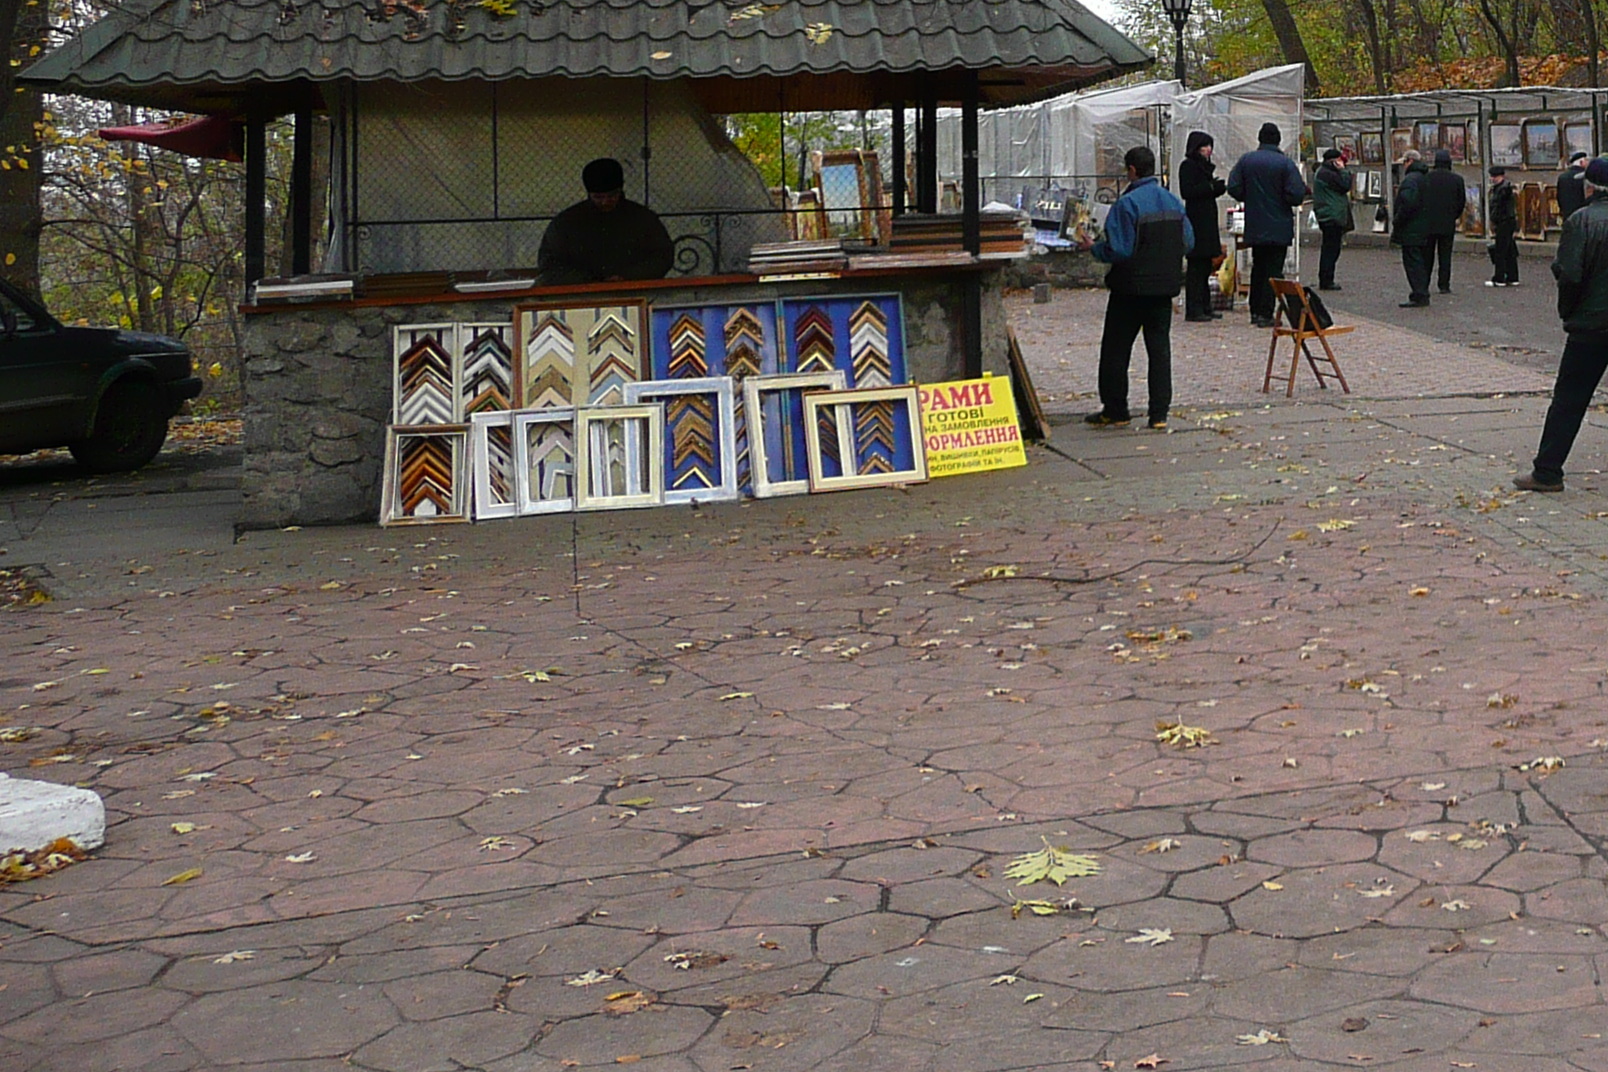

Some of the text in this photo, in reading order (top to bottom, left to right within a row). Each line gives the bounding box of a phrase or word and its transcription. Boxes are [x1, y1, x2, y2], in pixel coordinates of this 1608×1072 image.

[928, 407, 985, 424] ГОТОВІ
[924, 416, 1010, 434] НА ЗАМОВЛЕННЯ
